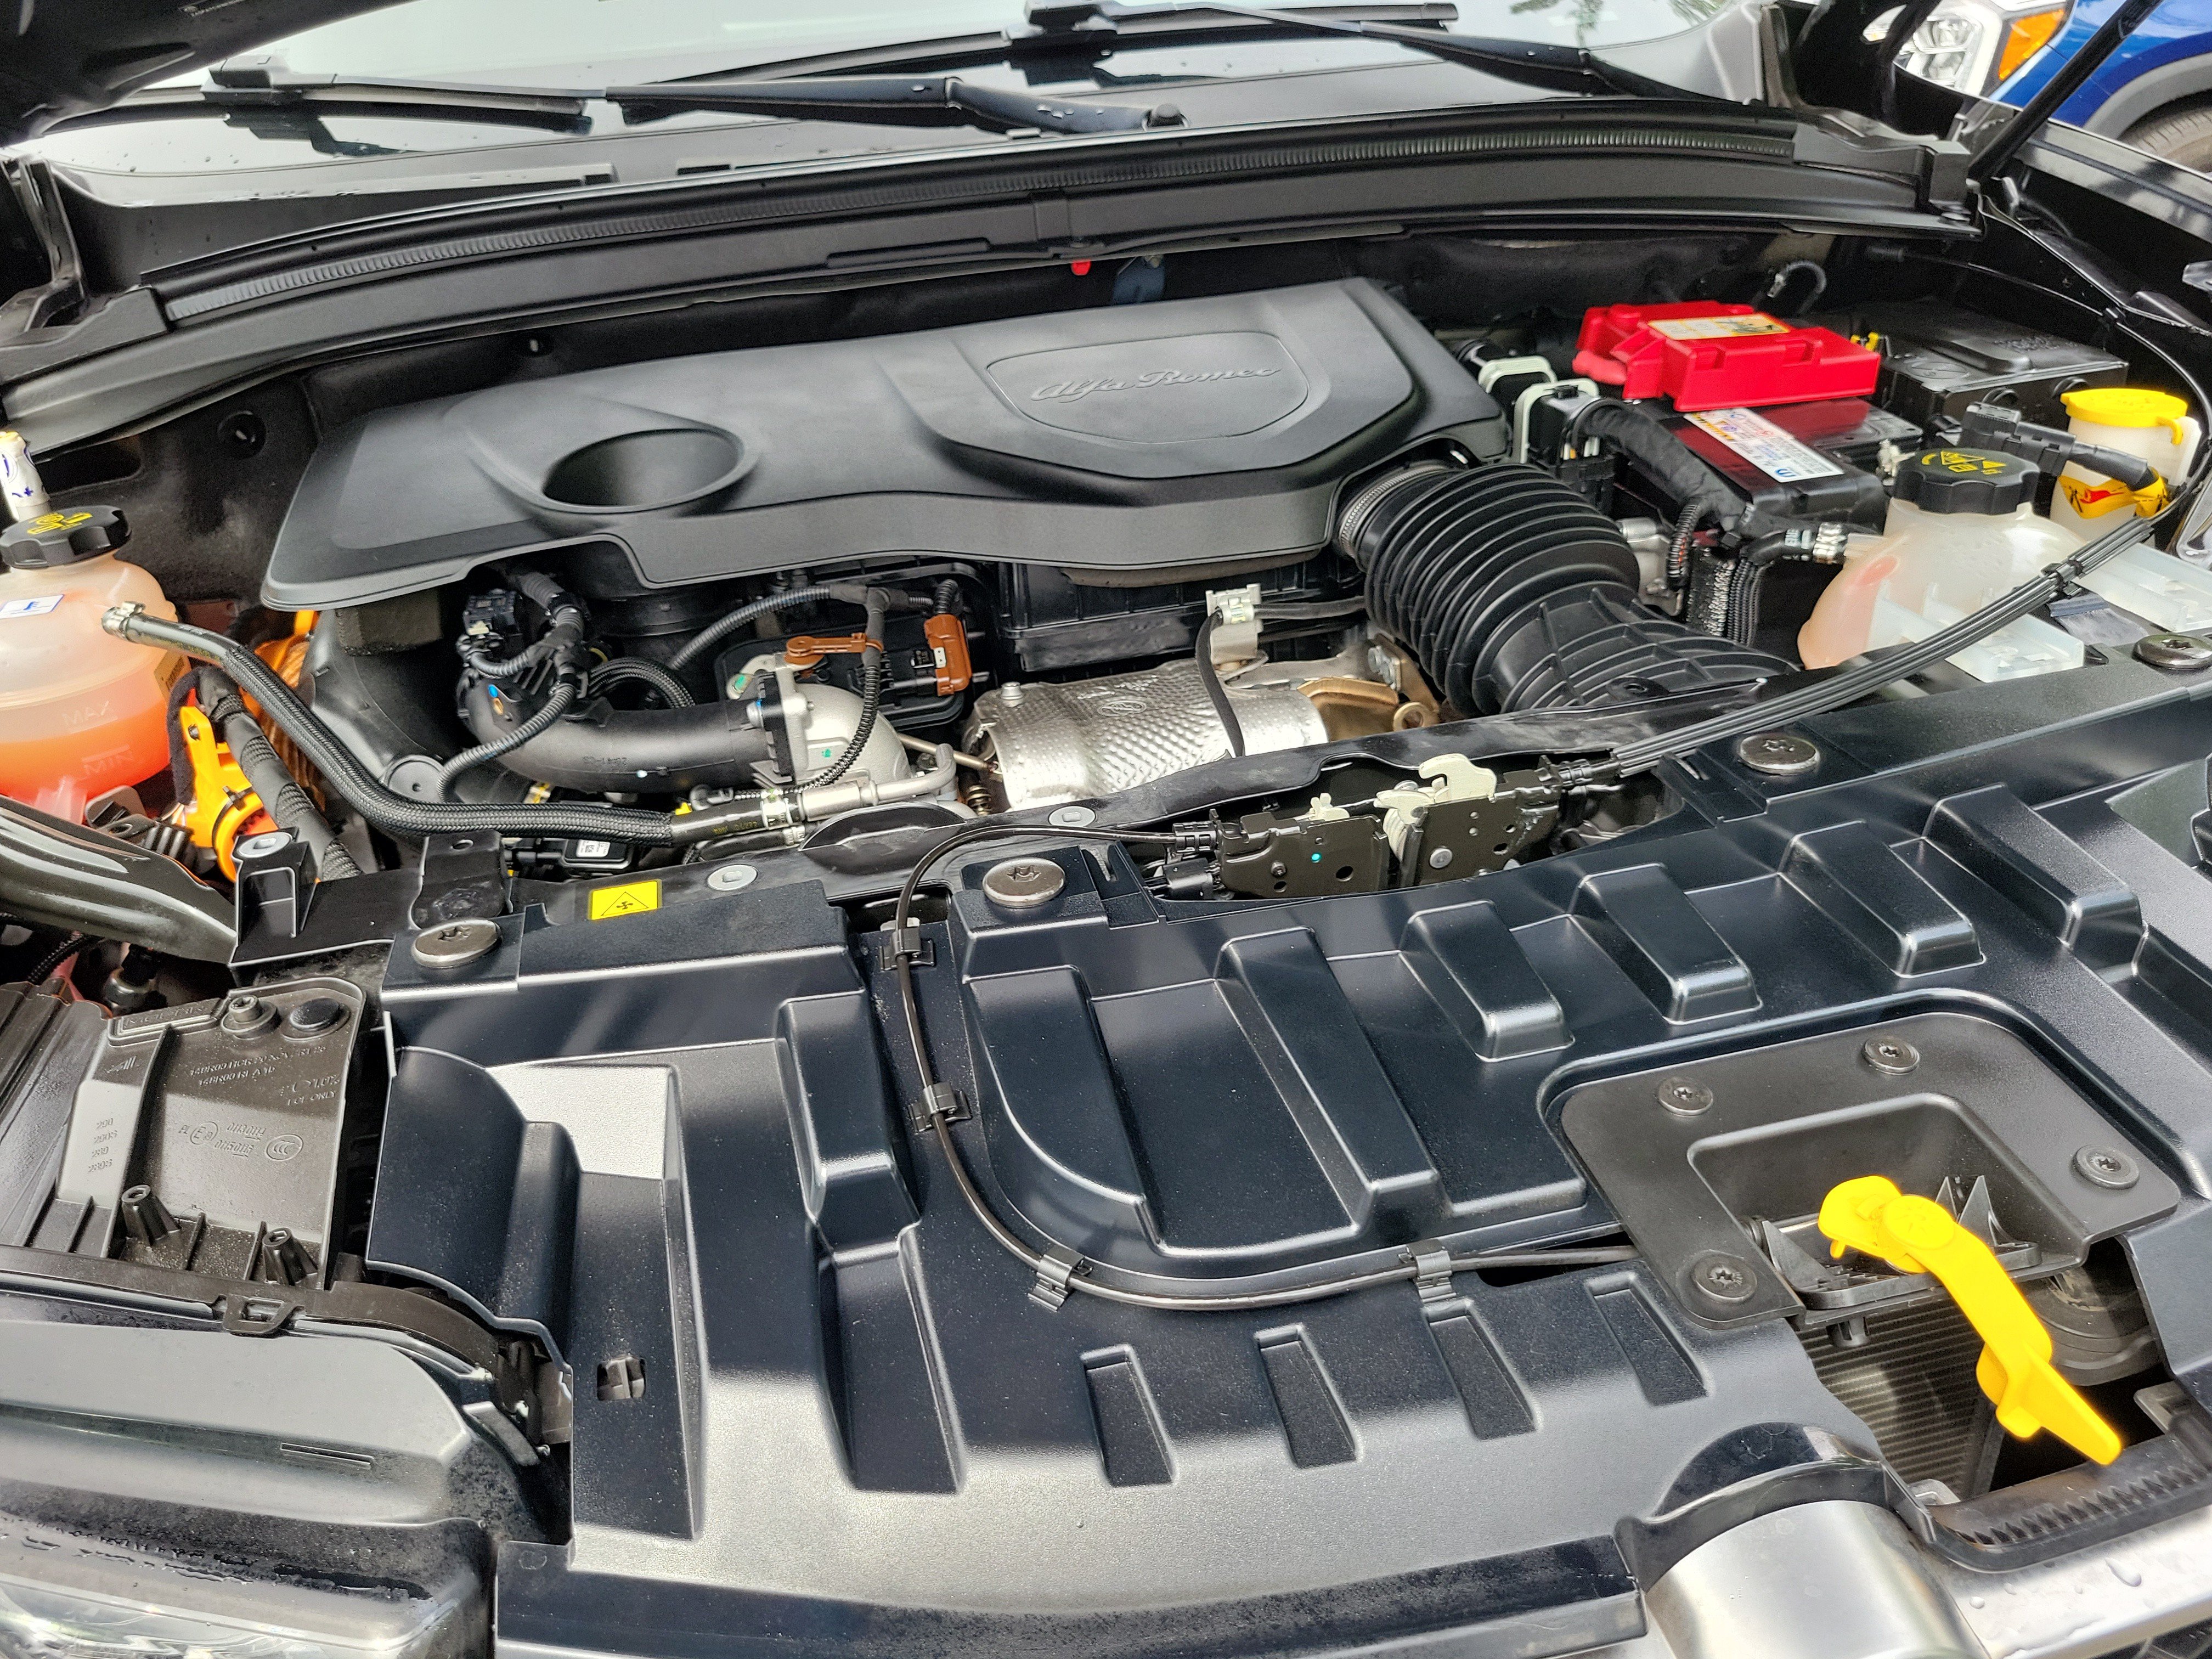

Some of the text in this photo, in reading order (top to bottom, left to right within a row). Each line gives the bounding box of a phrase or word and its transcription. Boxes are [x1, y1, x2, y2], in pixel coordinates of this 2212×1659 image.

[1031, 368, 1283, 403] Alfa Romeo
[97, 1118, 114, 1129] 290
